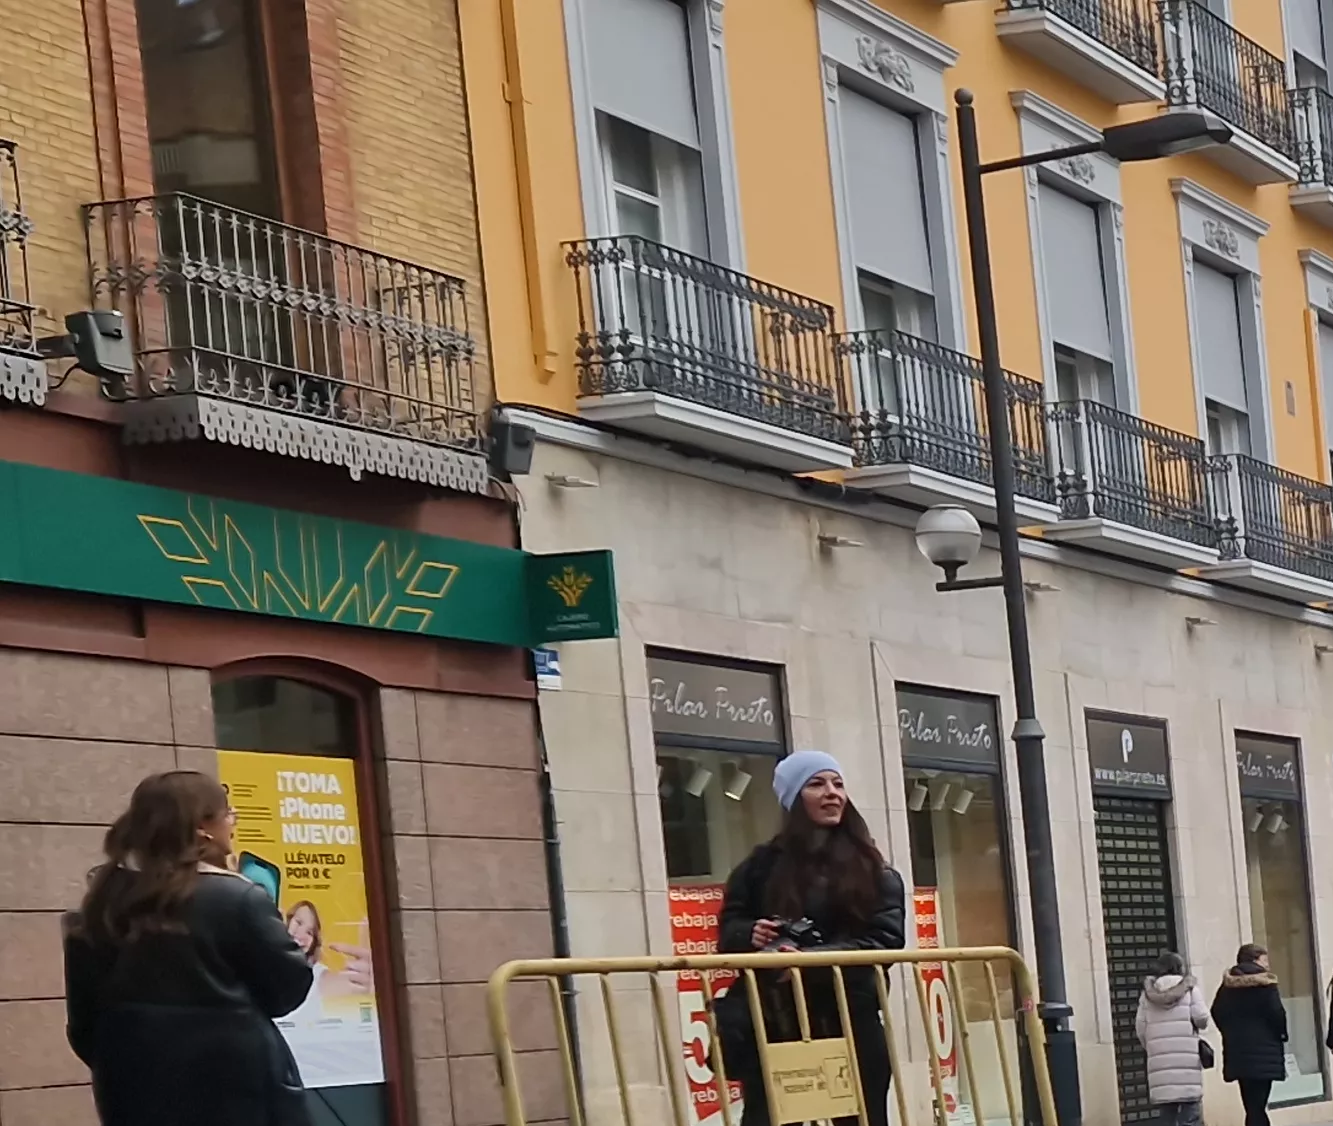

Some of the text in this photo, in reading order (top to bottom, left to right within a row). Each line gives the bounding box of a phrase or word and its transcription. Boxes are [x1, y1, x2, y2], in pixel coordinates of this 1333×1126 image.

[651, 678, 774, 726] Pilar Prieto
[899, 709, 992, 749] Pilar Prieto
[279, 797, 345, 820] iPhone
[282, 823, 357, 845] NUEVO!
[284, 851, 346, 865] LLÉVATELO
[286, 867, 310, 879] POR
